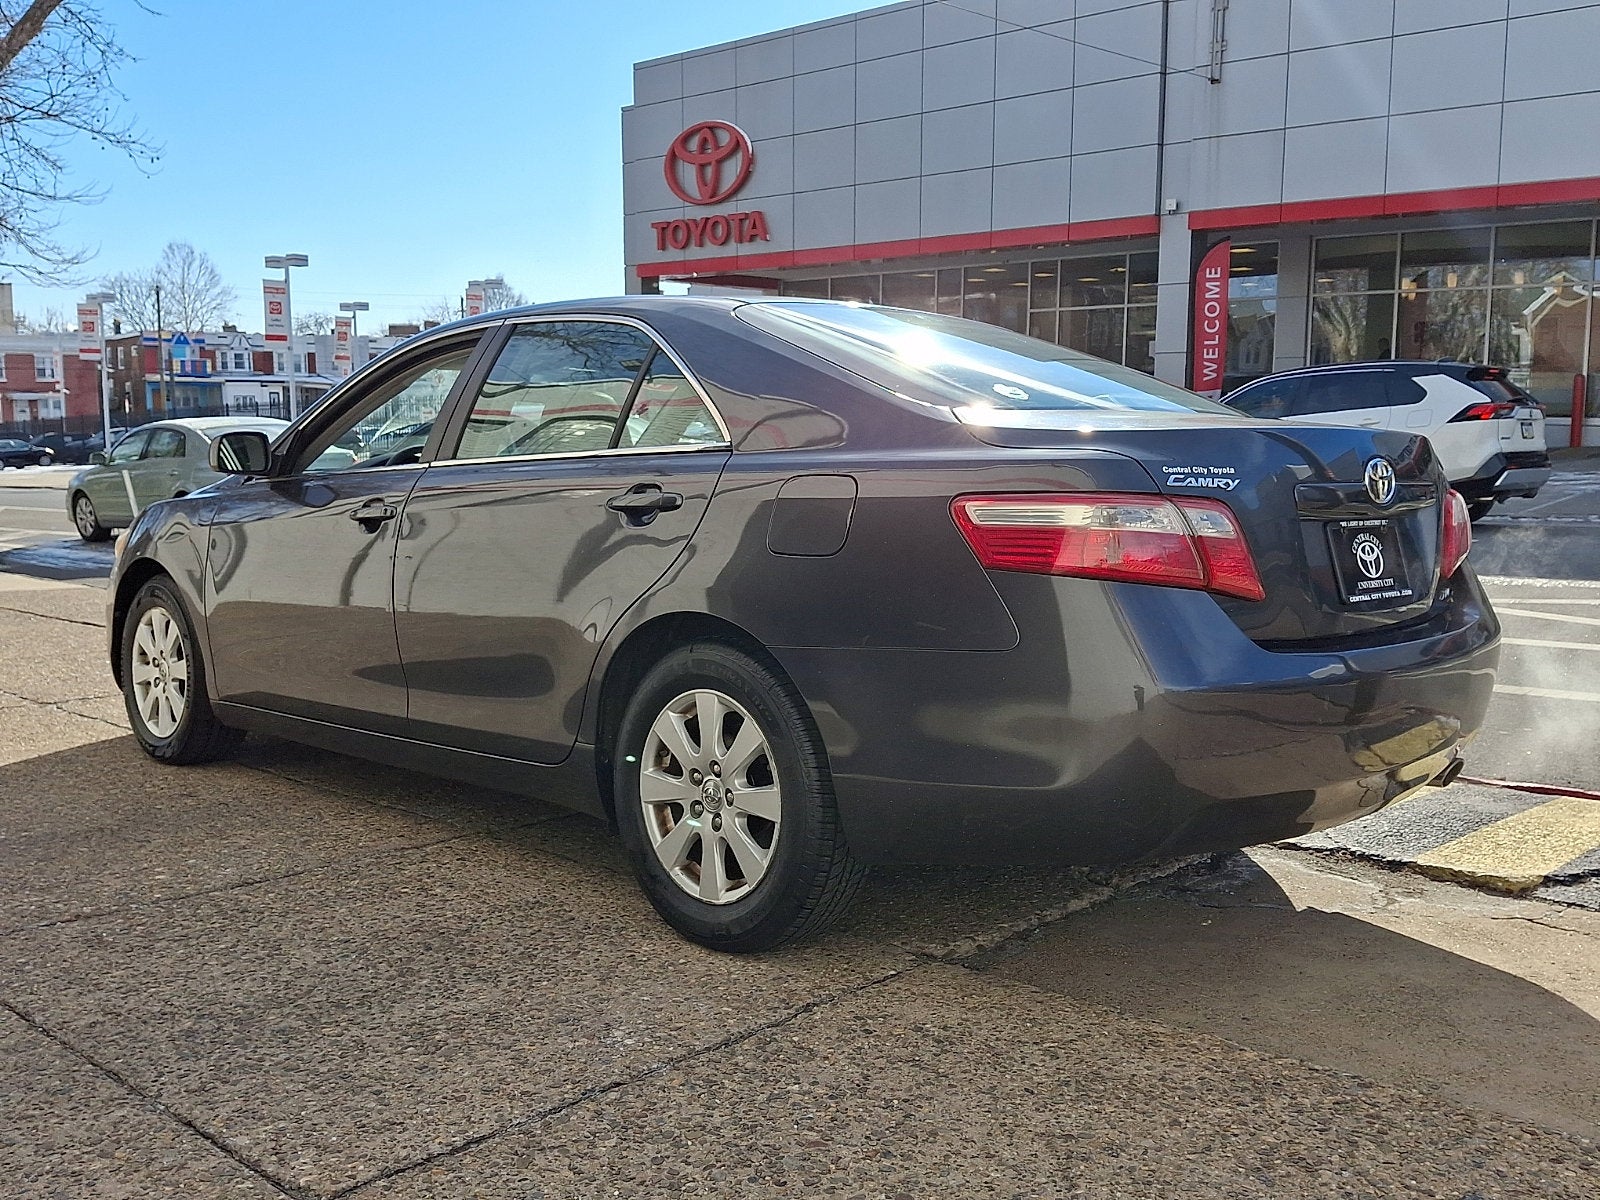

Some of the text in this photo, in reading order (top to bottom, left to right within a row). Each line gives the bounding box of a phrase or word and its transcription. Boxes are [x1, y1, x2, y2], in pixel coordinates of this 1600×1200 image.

[651, 211, 769, 251] TOYOTA
[1203, 266, 1221, 381] WELCOME
[1192, 466, 1208, 475] City
[1209, 466, 1235, 475] Toyota
[1166, 474, 1241, 491] CAMRY
[1352, 532, 1384, 554] CENTRAL CITY
[1357, 578, 1394, 590] UNIVERSITY CITY
[1349, 594, 1371, 602] CENTRAL
